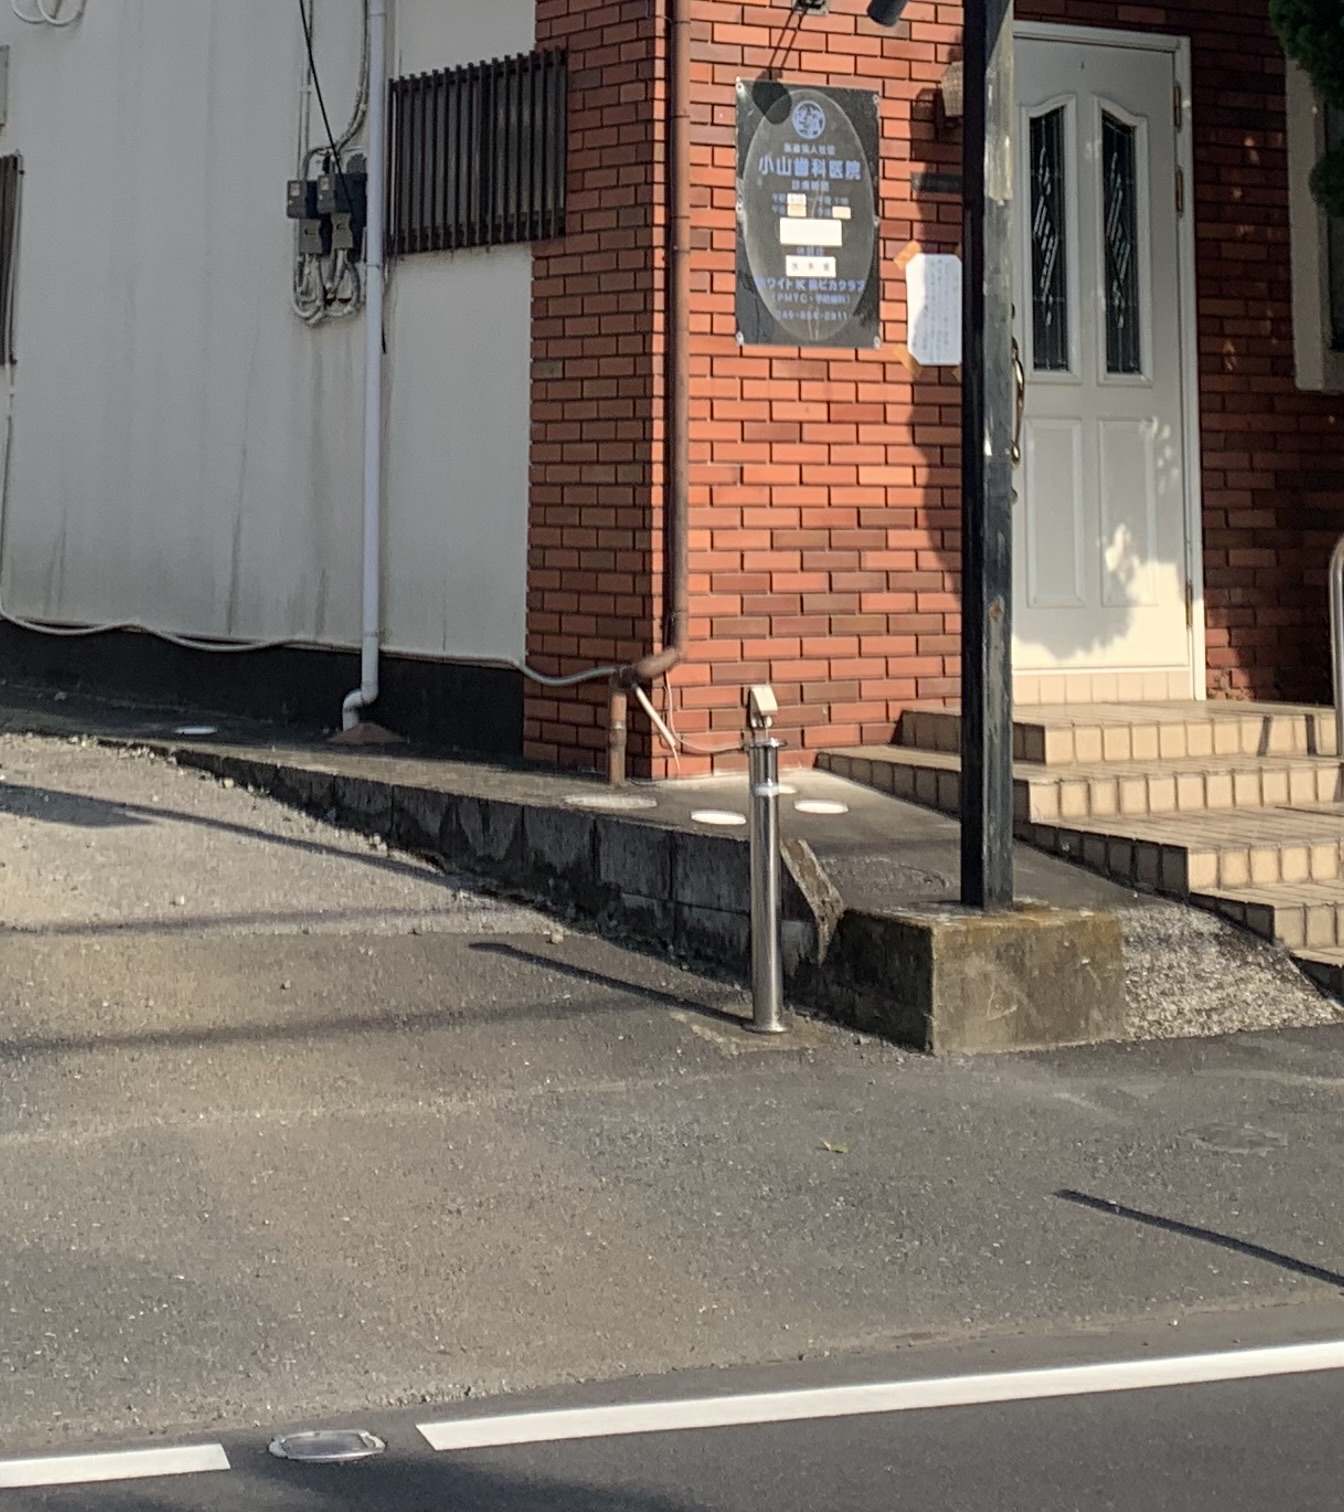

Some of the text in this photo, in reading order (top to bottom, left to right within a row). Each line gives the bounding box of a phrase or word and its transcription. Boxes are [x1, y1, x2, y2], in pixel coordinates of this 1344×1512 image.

[758, 155, 861, 180] 小山歯科医院
